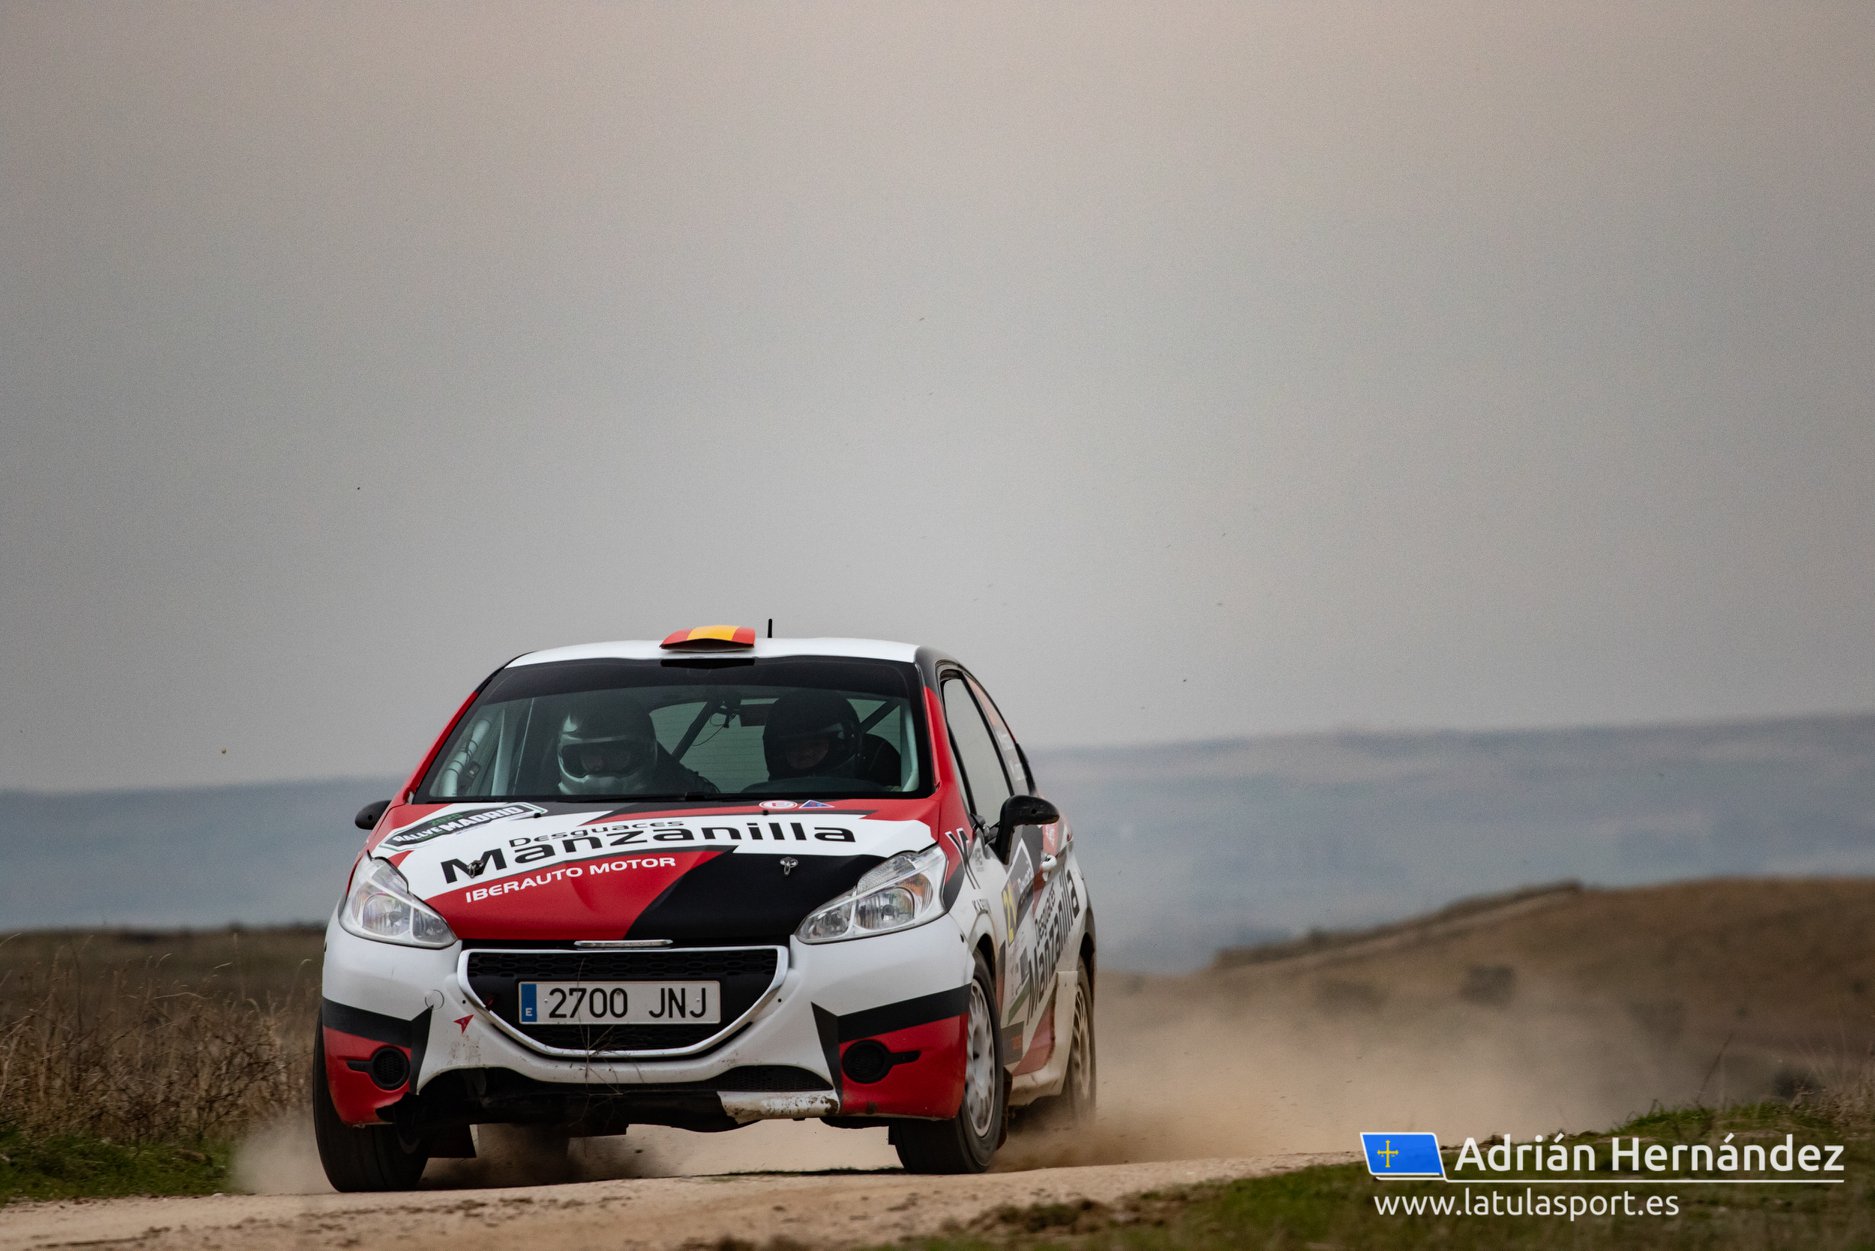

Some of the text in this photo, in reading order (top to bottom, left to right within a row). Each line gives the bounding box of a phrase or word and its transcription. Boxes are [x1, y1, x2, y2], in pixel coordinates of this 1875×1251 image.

[392, 805, 525, 843] RALLYE MADRID
[508, 820, 684, 848] Desguaces
[440, 822, 856, 884] Manzanilla
[465, 857, 676, 903] IBERAUTO MOTOR
[1026, 863, 1080, 1026] Manzanilla
[525, 1008, 533, 1016] E
[548, 987, 707, 1018] 2700 JNJ
